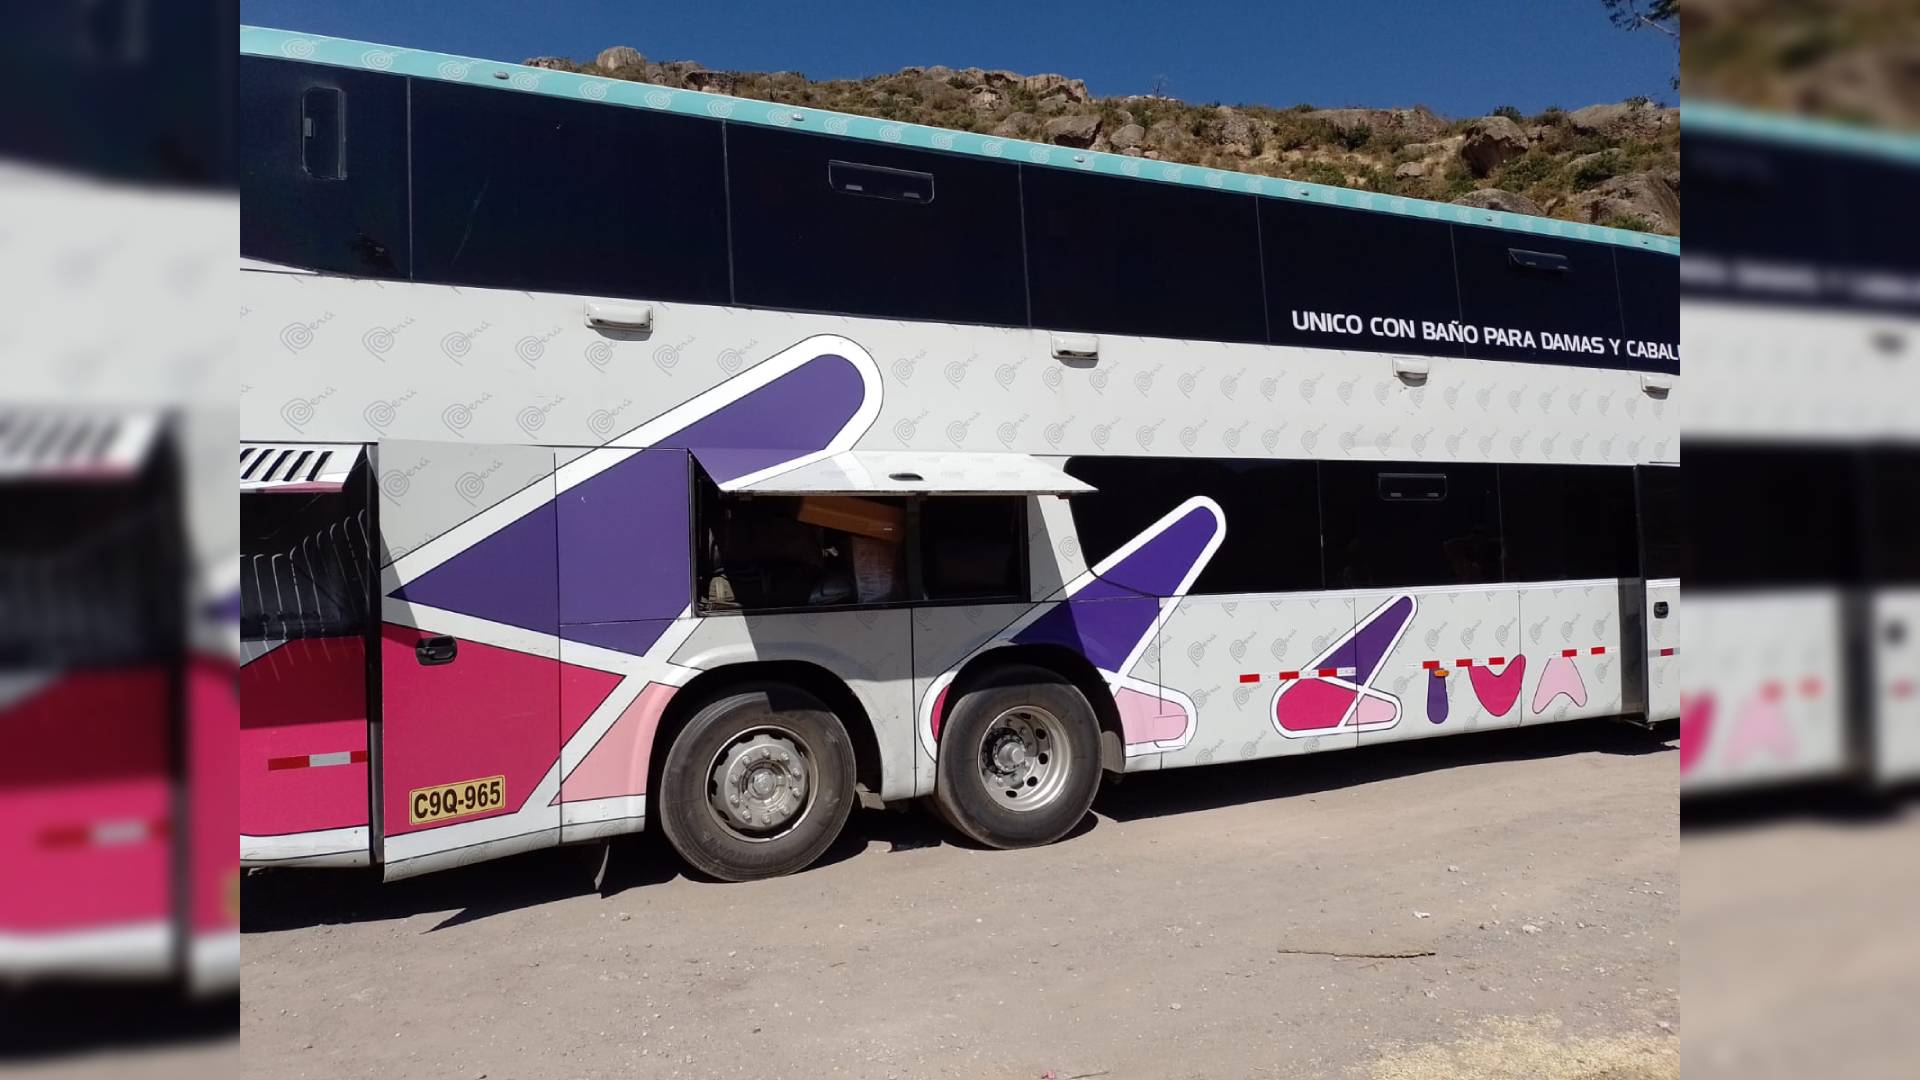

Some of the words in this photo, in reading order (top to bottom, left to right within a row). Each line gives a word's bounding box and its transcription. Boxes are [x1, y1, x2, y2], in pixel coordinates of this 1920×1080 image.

[1292, 310, 1363, 335] UNICO
[1370, 317, 1416, 339] CON
[1421, 320, 1479, 344] BAÑO
[1483, 326, 1537, 349] PARA
[1540, 332, 1605, 355] DAMAS
[1608, 338, 1621, 356] Y
[414, 781, 501, 819] C9Q-965
